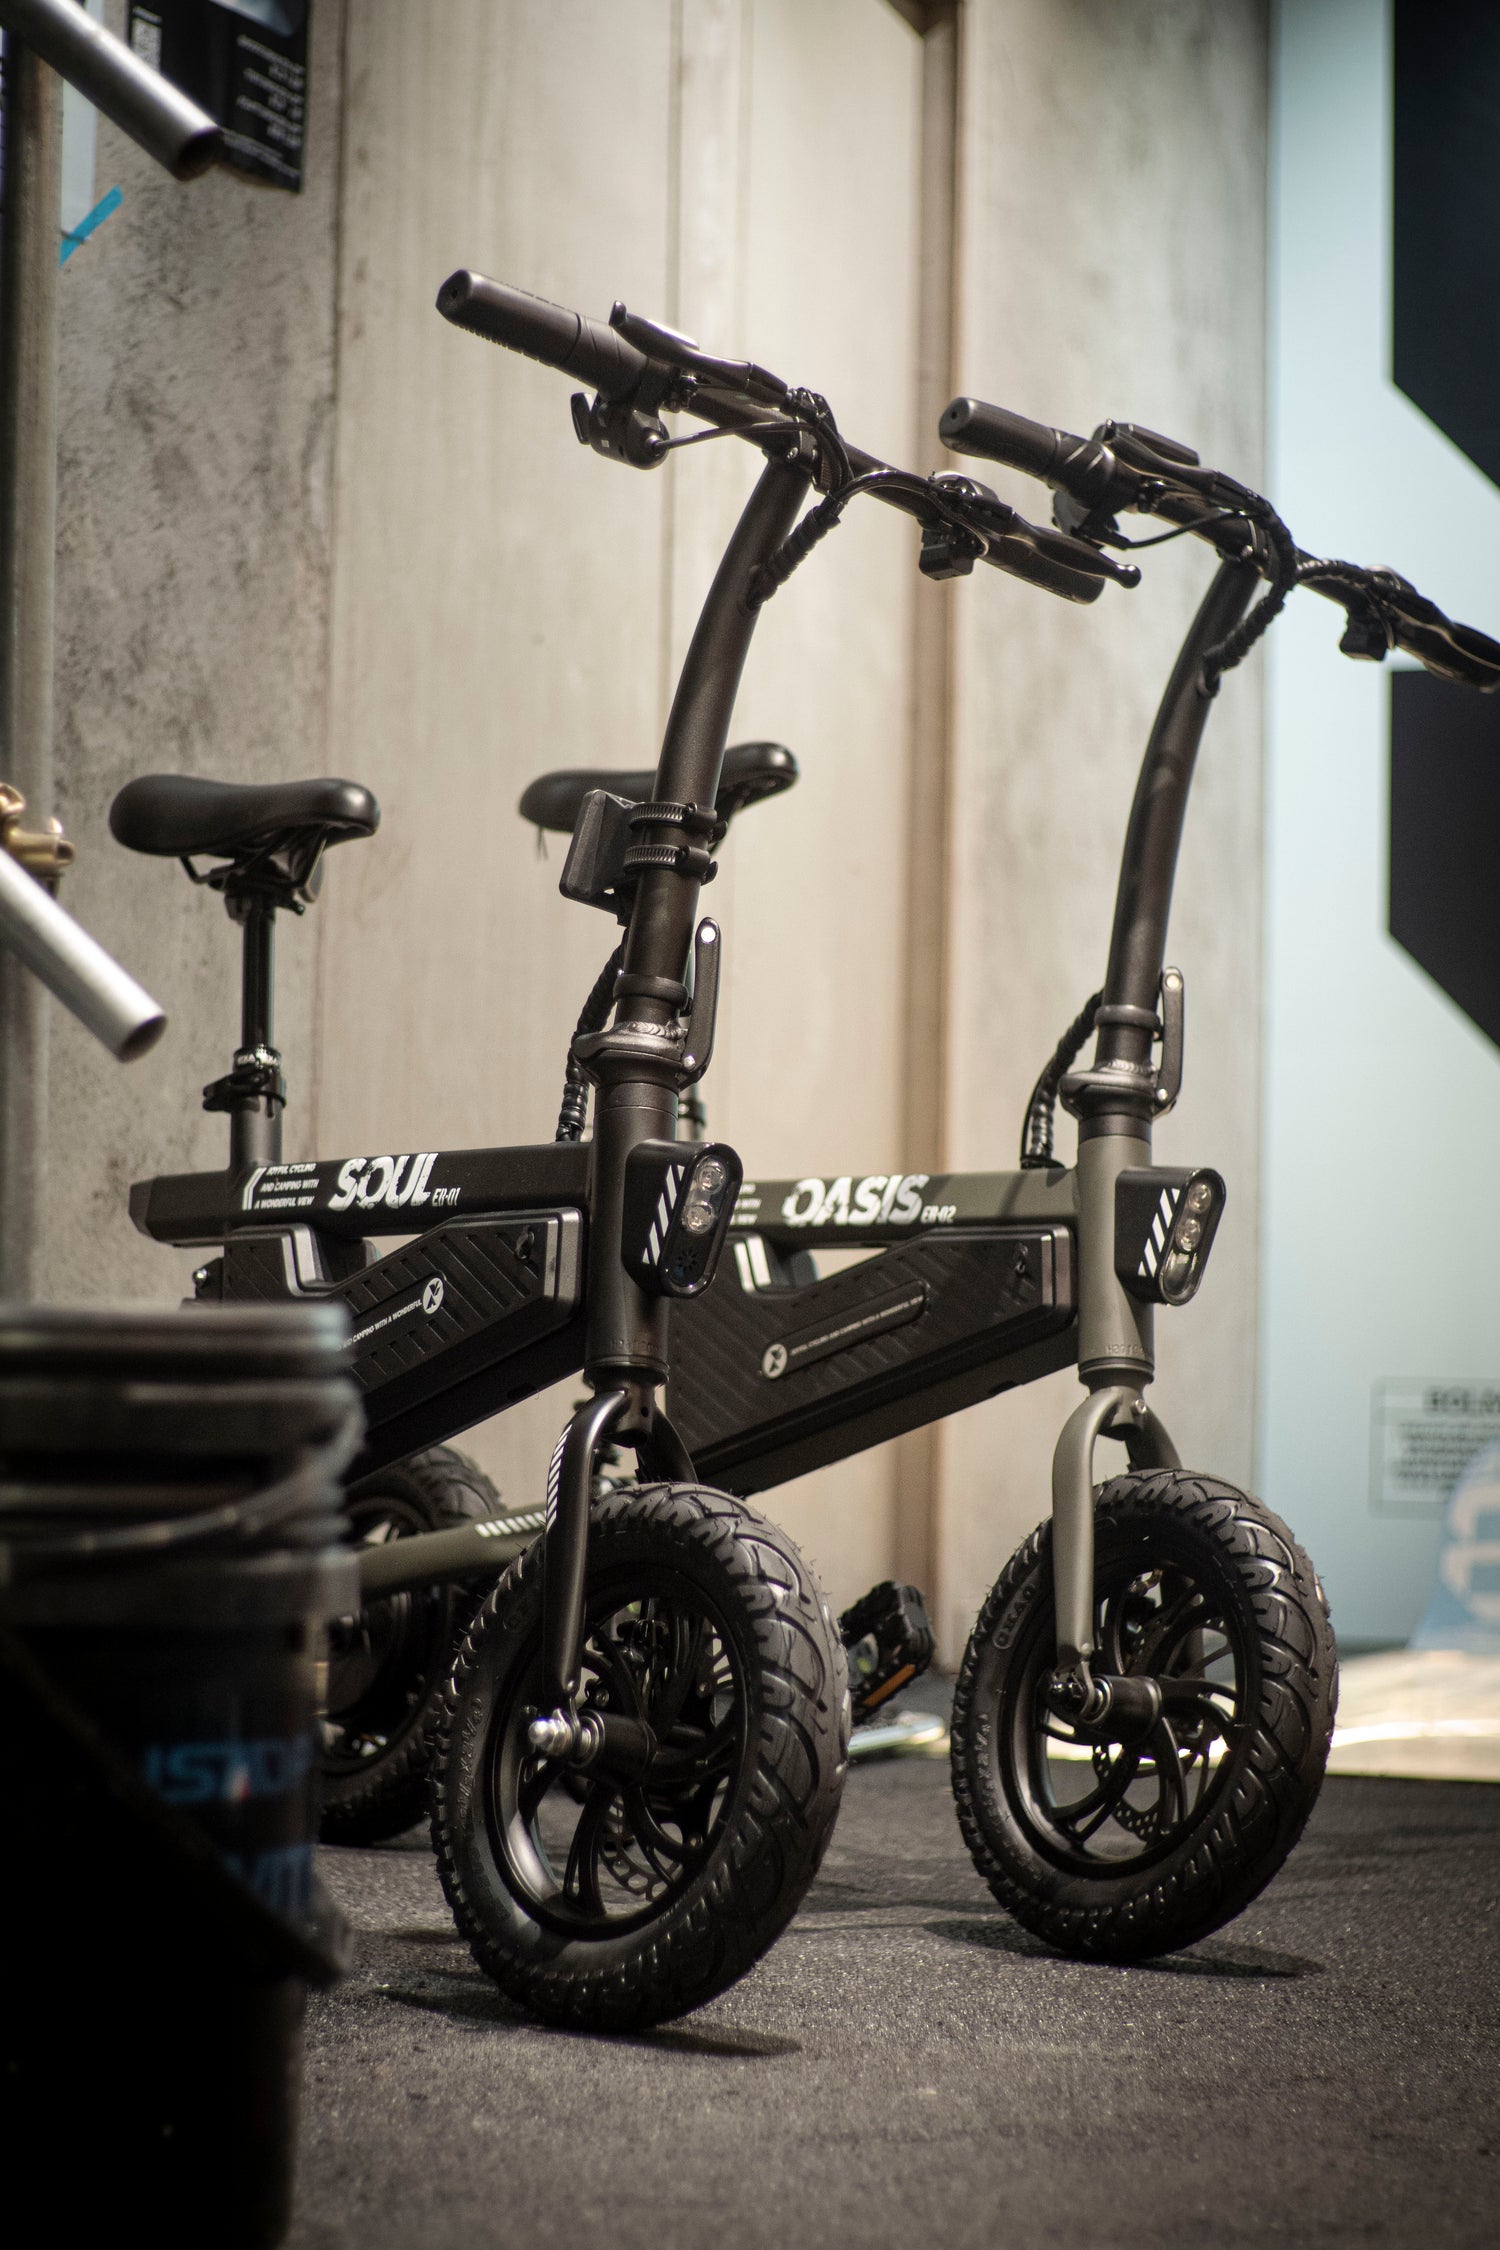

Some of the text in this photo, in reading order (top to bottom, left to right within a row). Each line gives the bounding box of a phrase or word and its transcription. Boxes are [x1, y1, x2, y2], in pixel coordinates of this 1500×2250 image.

[289, 1163, 317, 1174] CYCLING
[260, 1178, 320, 1192] AND CAMPING WITH
[327, 1152, 439, 1212] SOUL
[297, 1195, 315, 1207] VIEW
[781, 1174, 930, 1228] OASIS
